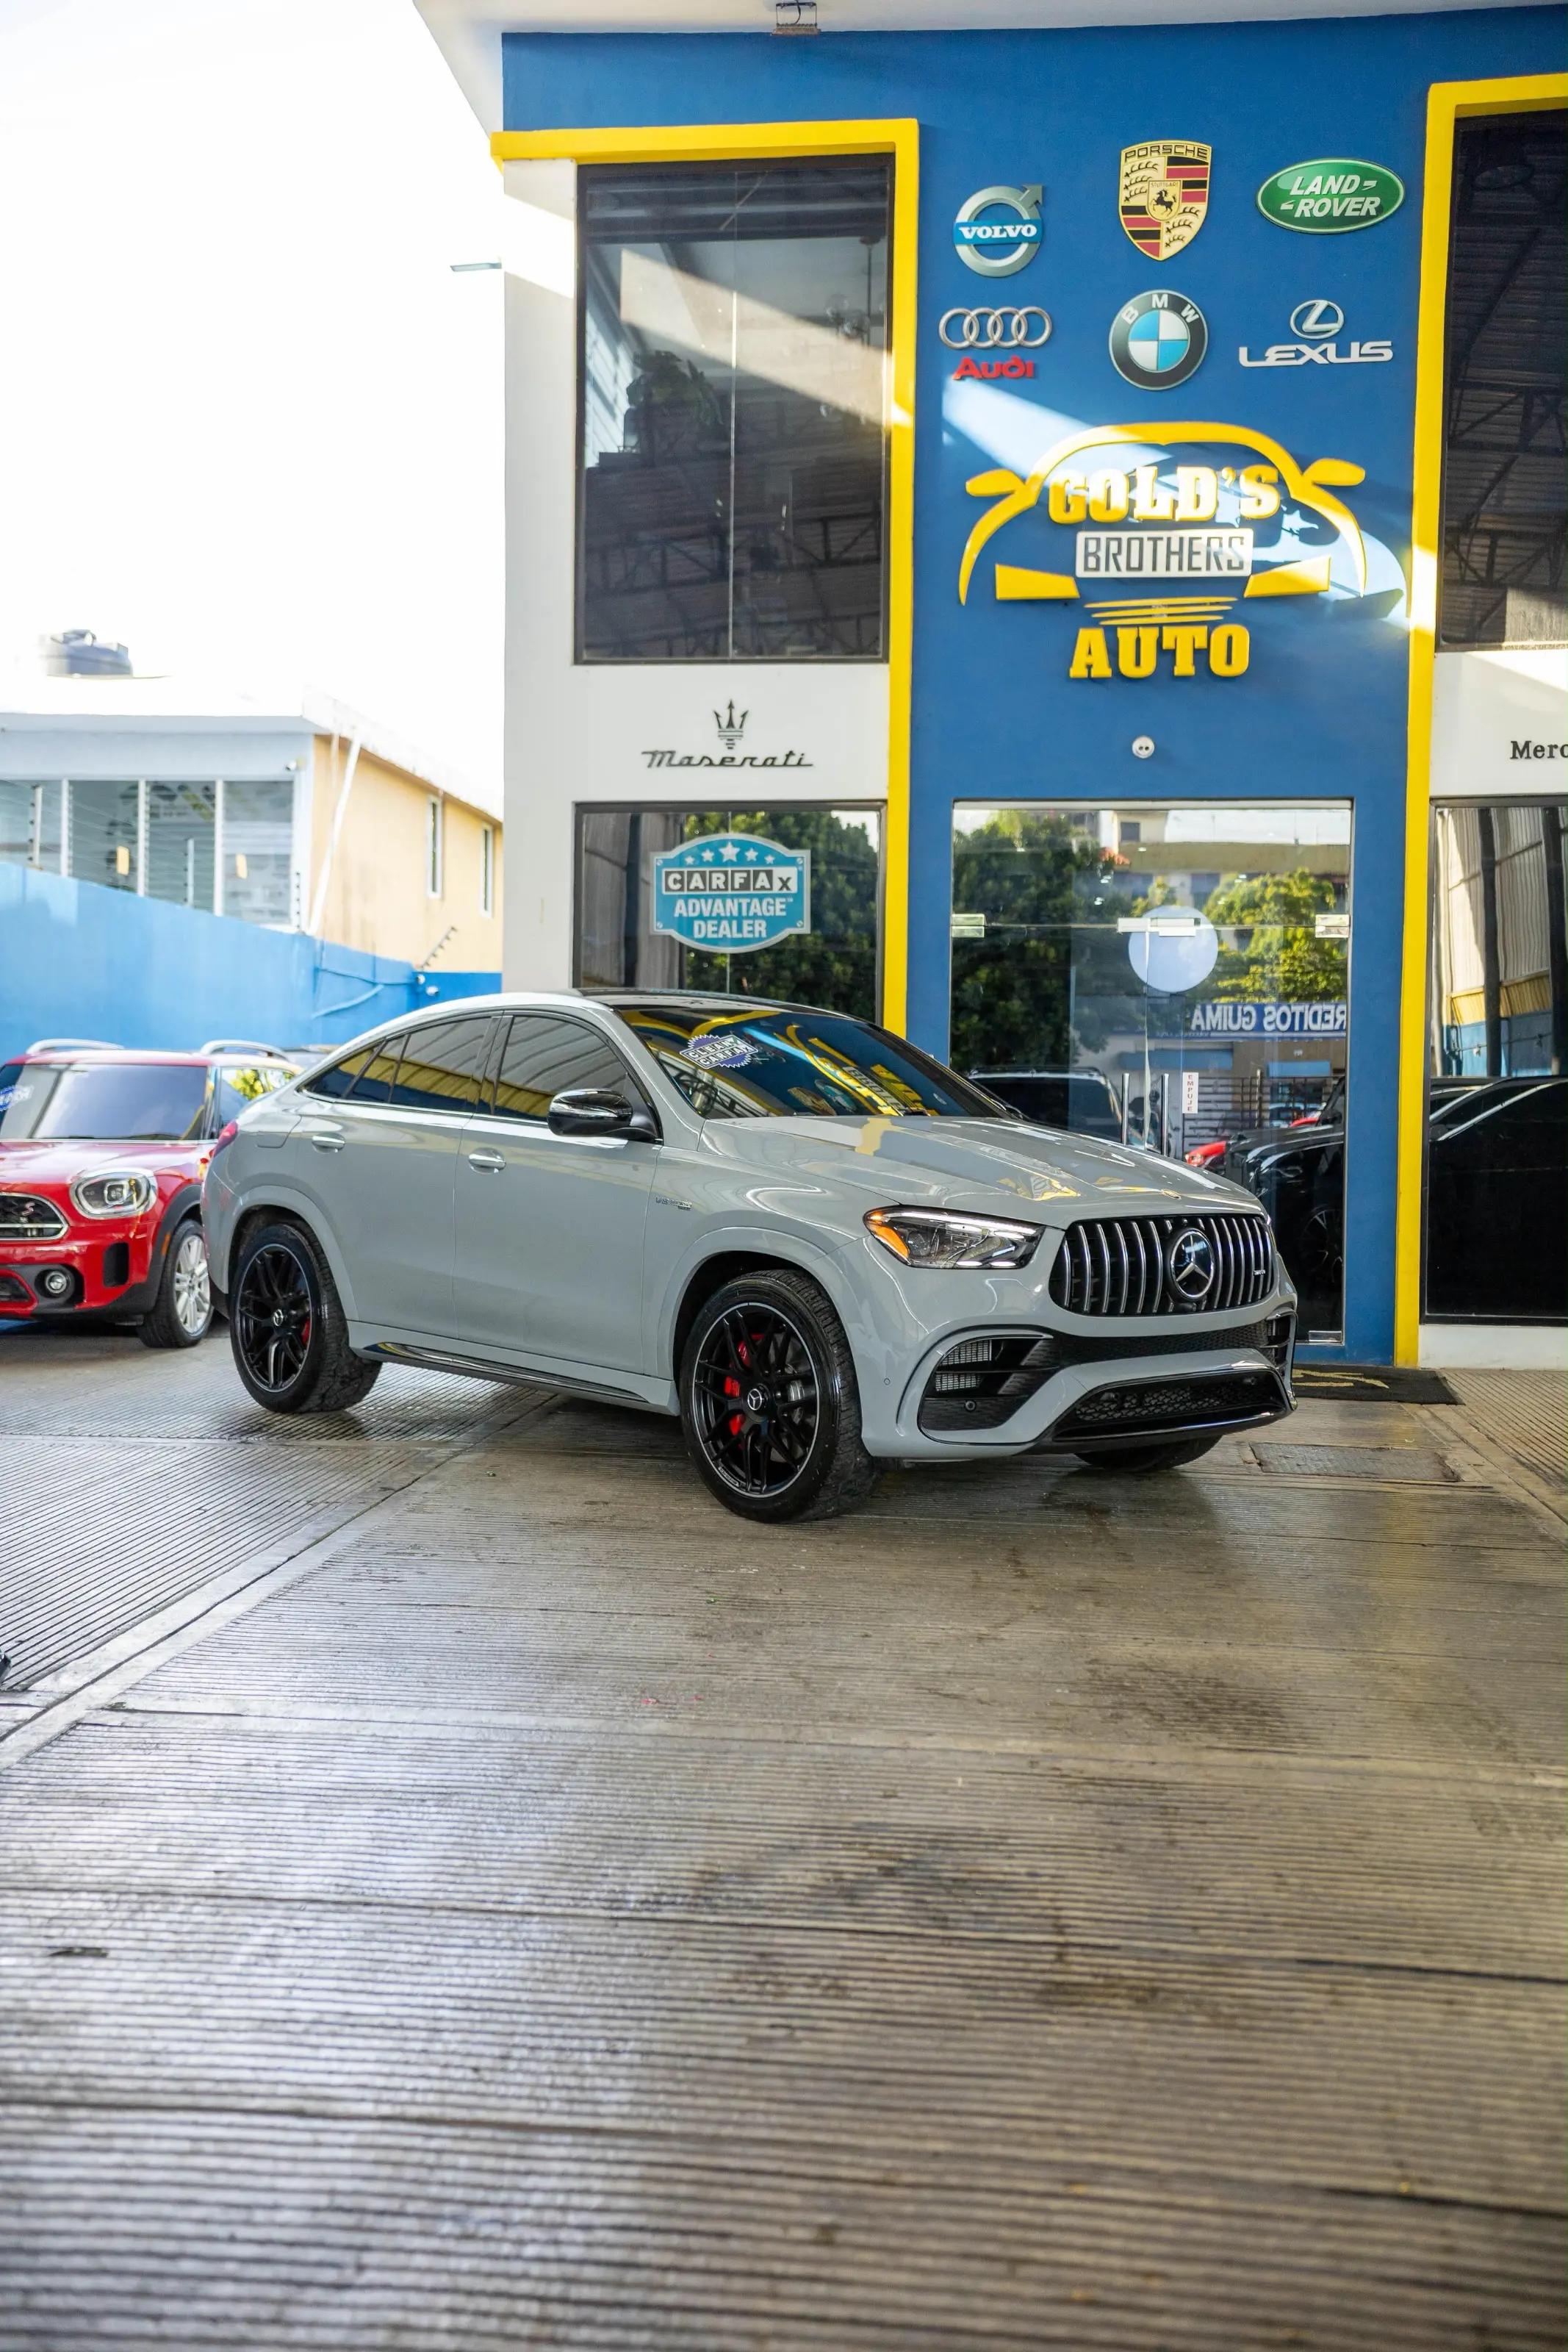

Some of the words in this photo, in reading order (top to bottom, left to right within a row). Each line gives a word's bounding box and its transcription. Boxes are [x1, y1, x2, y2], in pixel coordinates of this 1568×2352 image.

[1125, 144, 1207, 162] PORSCHE
[959, 224, 1037, 239] VOLVO
[1121, 293, 1199, 325] BMW
[1239, 341, 1393, 367] LEXUS
[952, 356, 1035, 379] Audi
[1084, 537, 1245, 573] BROTHERS
[1069, 624, 1250, 678] AUTO
[641, 750, 813, 769] Maserati
[1509, 740, 1568, 759] Merc
[664, 868, 797, 892] CARFAX
[693, 919, 767, 939] DEALER
[688, 1037, 735, 1058] CLEAN
